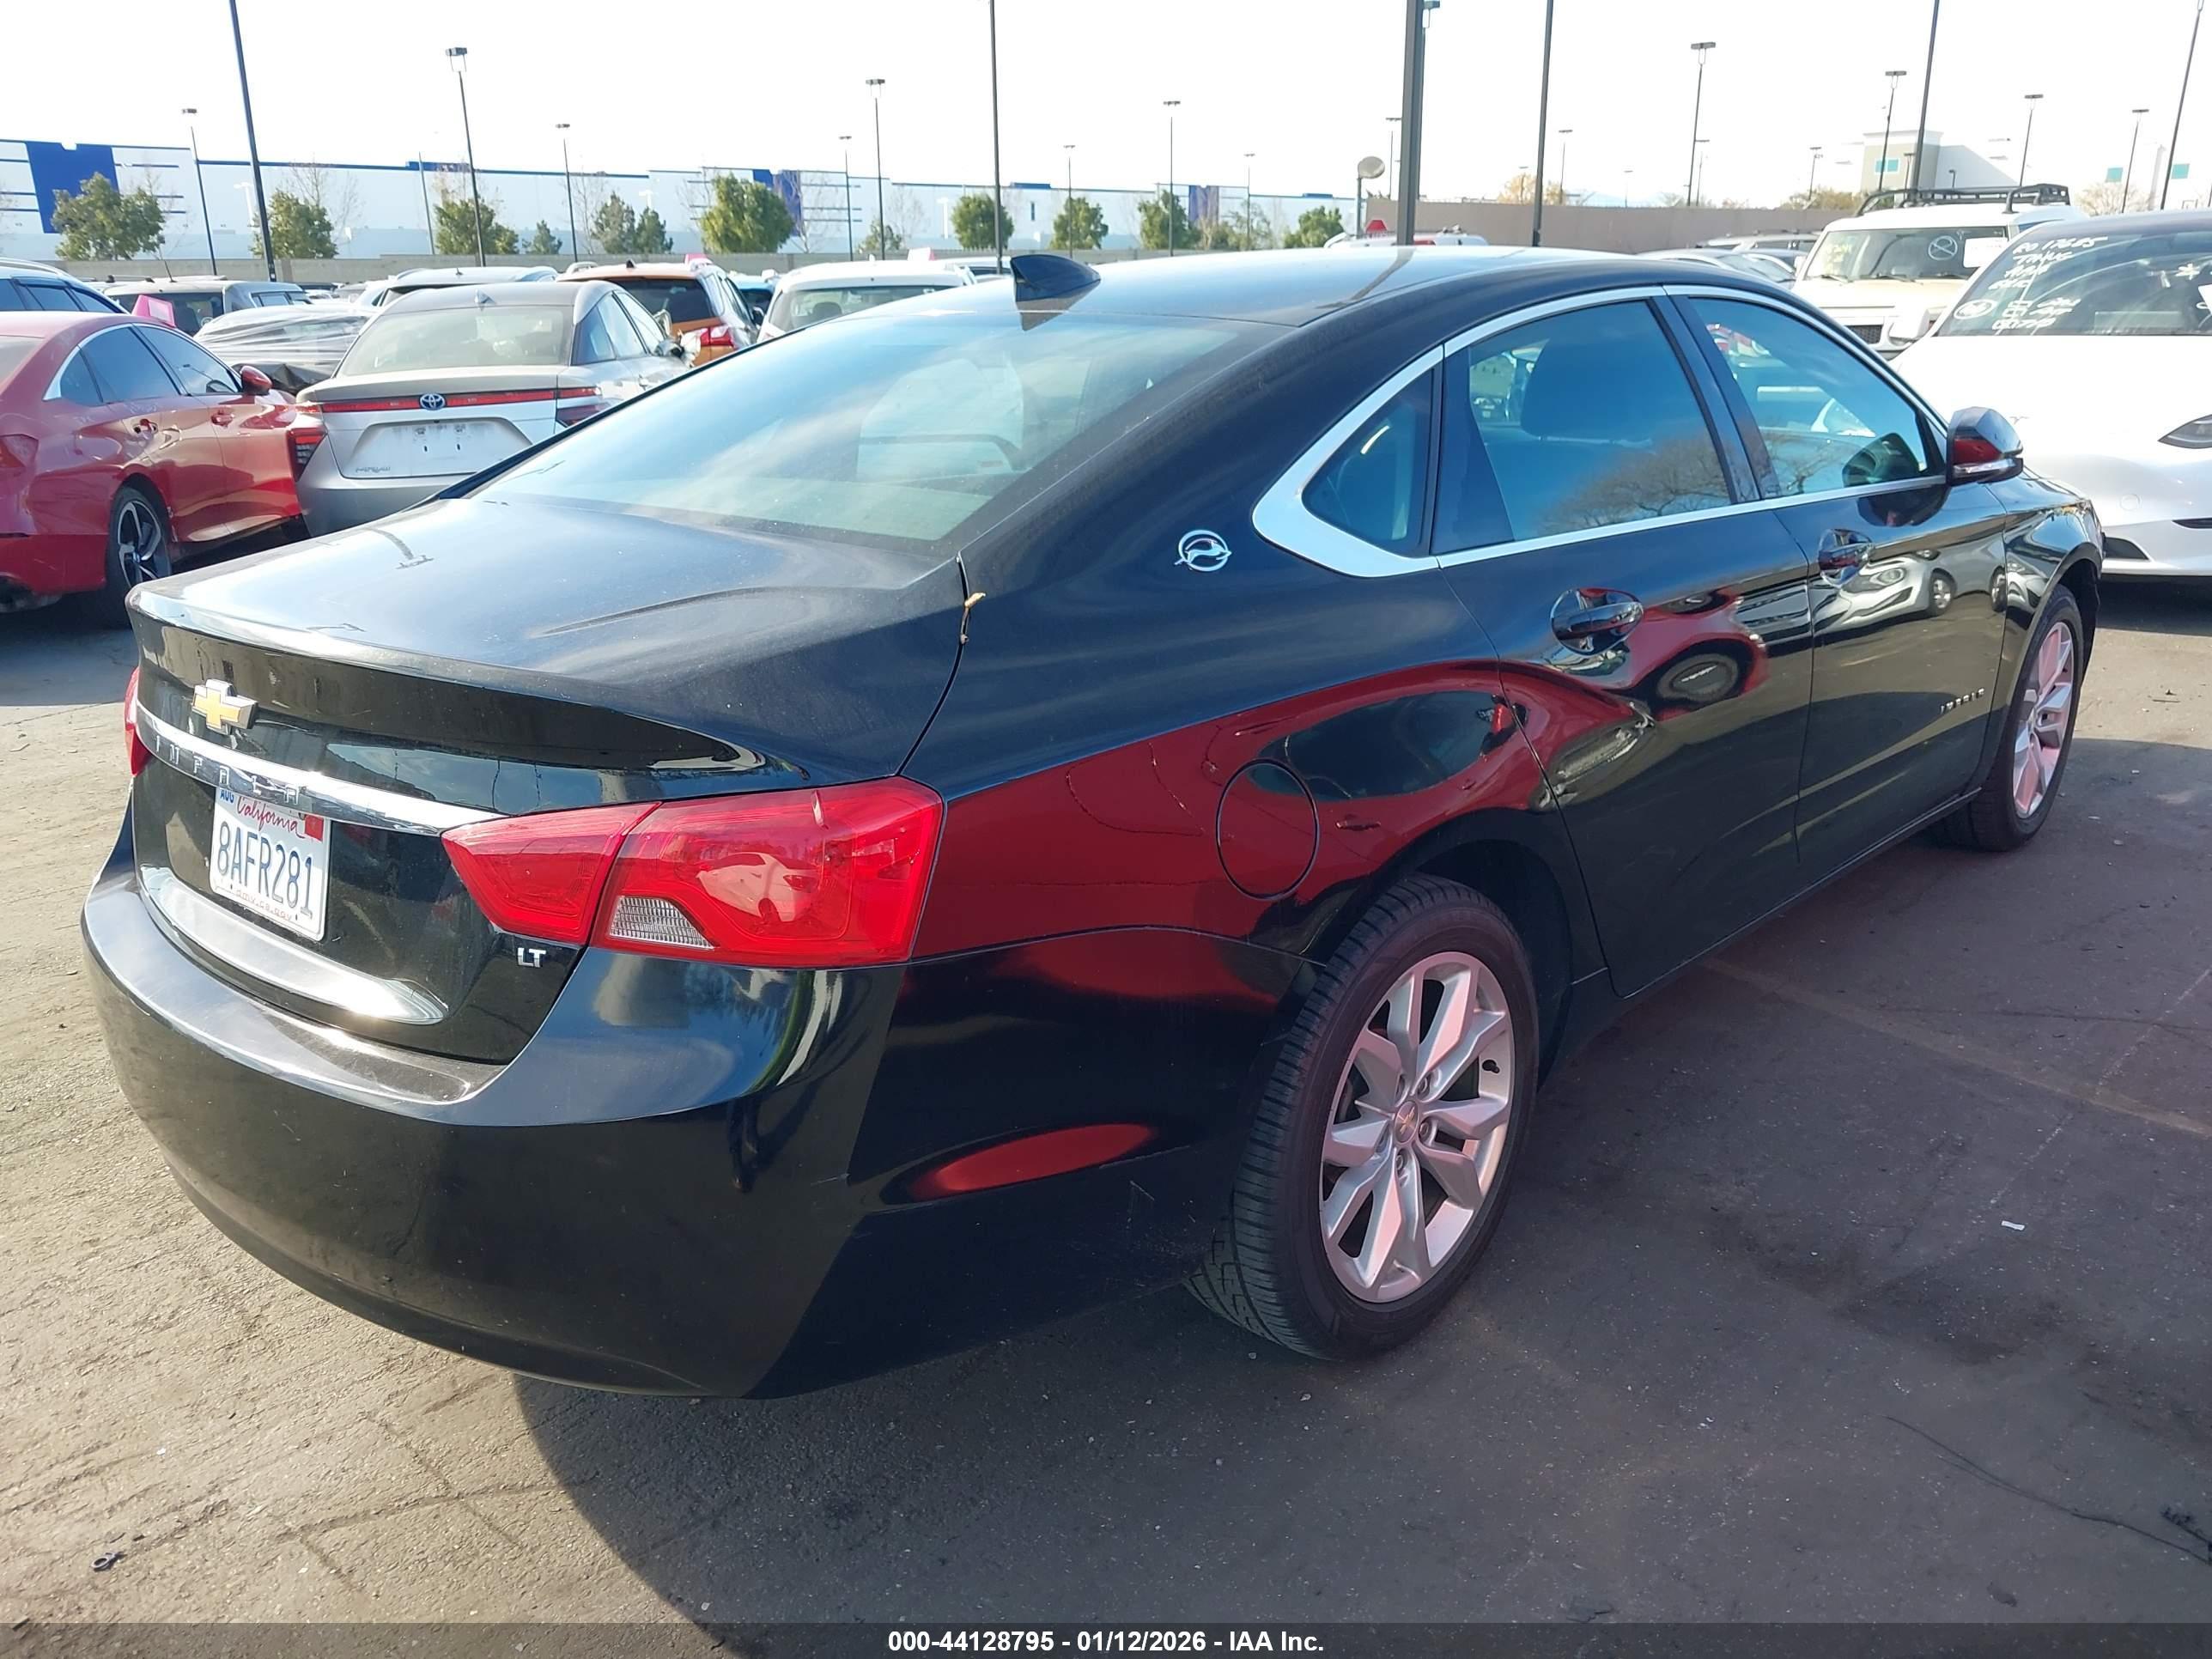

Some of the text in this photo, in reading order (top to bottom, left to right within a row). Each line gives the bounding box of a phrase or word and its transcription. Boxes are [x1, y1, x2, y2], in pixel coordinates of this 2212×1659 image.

[235, 795, 306, 839] California
[216, 820, 313, 920] 8AFR281
[517, 947, 547, 969] LT
